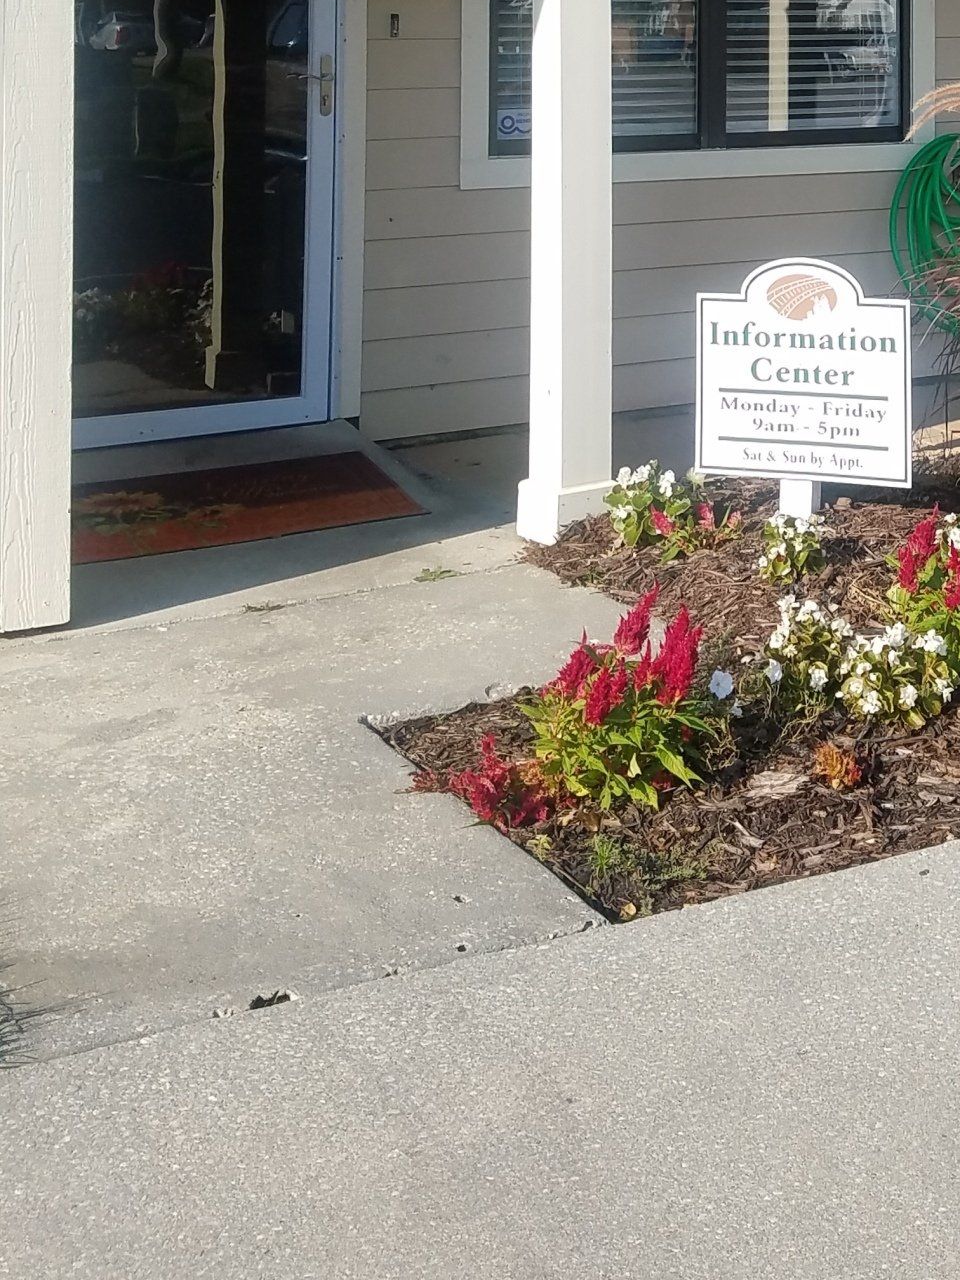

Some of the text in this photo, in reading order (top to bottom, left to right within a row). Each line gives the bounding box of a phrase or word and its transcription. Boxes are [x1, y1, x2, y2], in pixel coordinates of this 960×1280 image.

[709, 320, 898, 354] Information
[750, 356, 855, 387] Center
[720, 396, 800, 417] Monday
[822, 401, 887, 423] Friday
[752, 417, 796, 433] 9am
[817, 421, 860, 439] 5pm
[743, 447, 864, 471] Sat & Sun by Appt.
